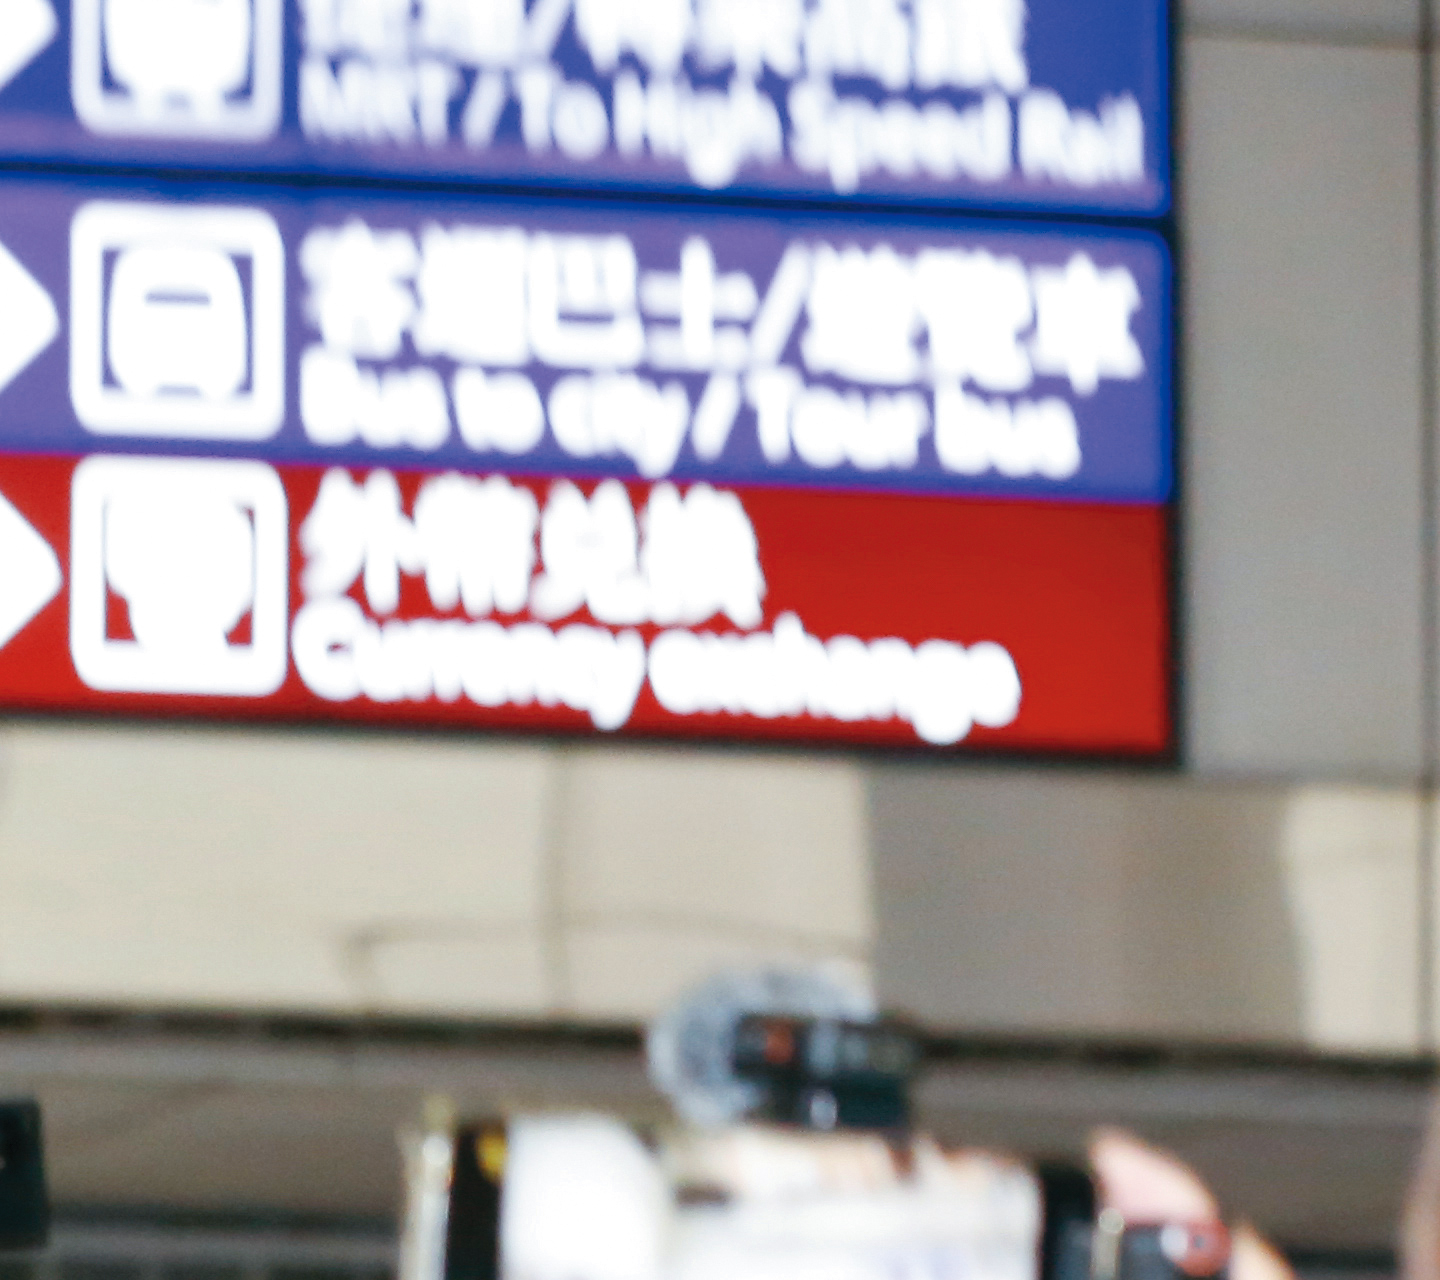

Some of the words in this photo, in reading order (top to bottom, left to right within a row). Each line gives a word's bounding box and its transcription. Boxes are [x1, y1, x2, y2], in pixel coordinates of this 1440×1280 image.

[298, 57, 459, 150] MRT
[612, 68, 781, 190] High
[787, 80, 1011, 195] Speed
[1018, 86, 1146, 189] Rail
[299, 346, 447, 446] Bus
[454, 364, 542, 452] to
[548, 370, 689, 476] city
[746, 369, 926, 468] Tour
[936, 380, 1080, 478] bus
[292, 595, 647, 731] Currency
[648, 614, 1021, 743] exchange
